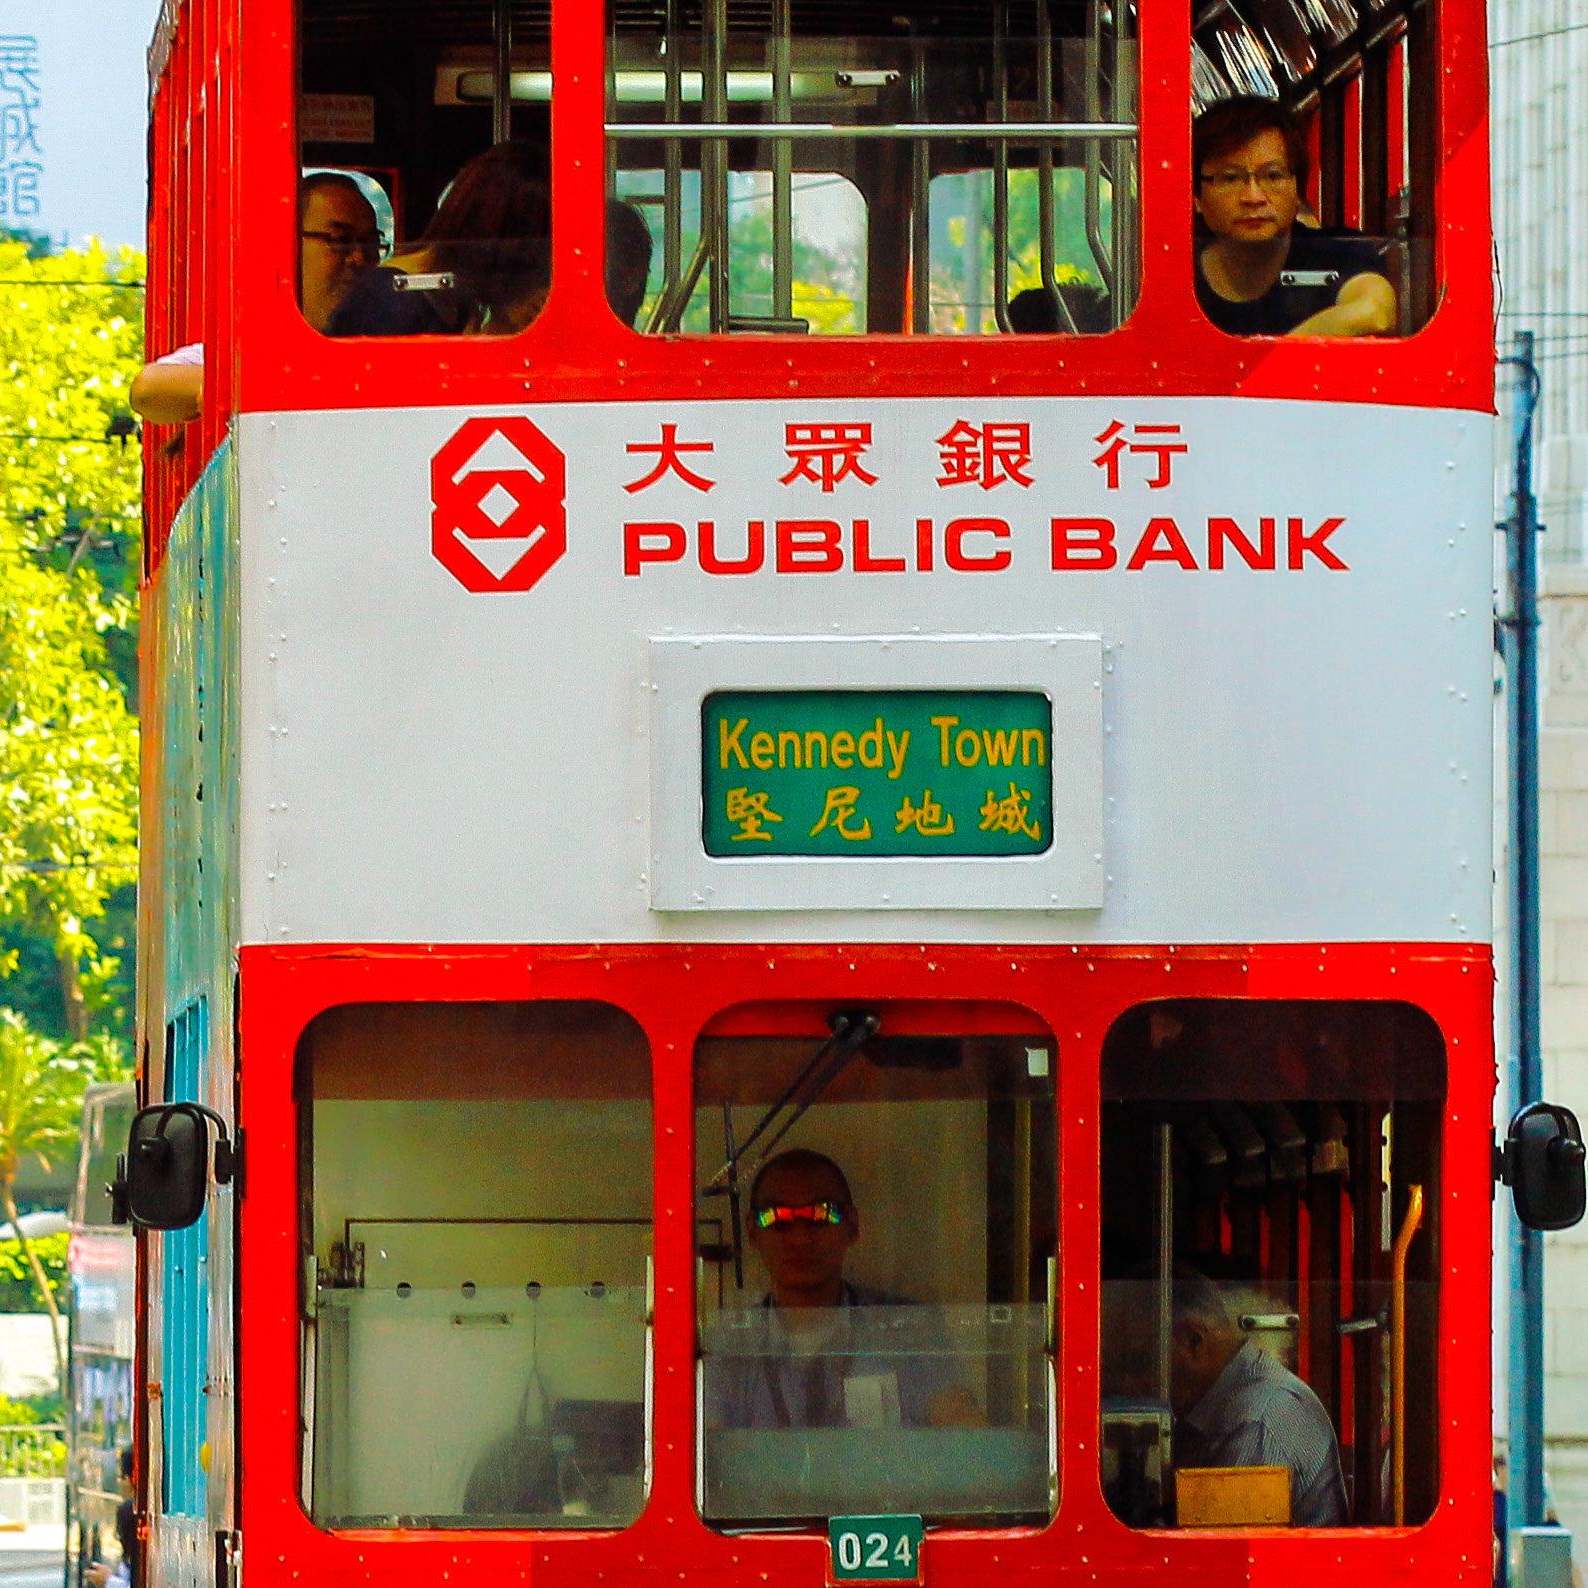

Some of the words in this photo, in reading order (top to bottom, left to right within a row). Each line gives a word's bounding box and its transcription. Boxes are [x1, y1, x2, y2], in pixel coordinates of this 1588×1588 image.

[623, 419, 1187, 494] 大眾銀行
[623, 517, 1012, 577] PUBLIC
[1051, 517, 1350, 572] BANK
[719, 718, 911, 779] Kennedy
[931, 716, 1046, 768] Town
[725, 782, 1042, 842] 堅尼地城
[838, 1532, 913, 1570] 024
